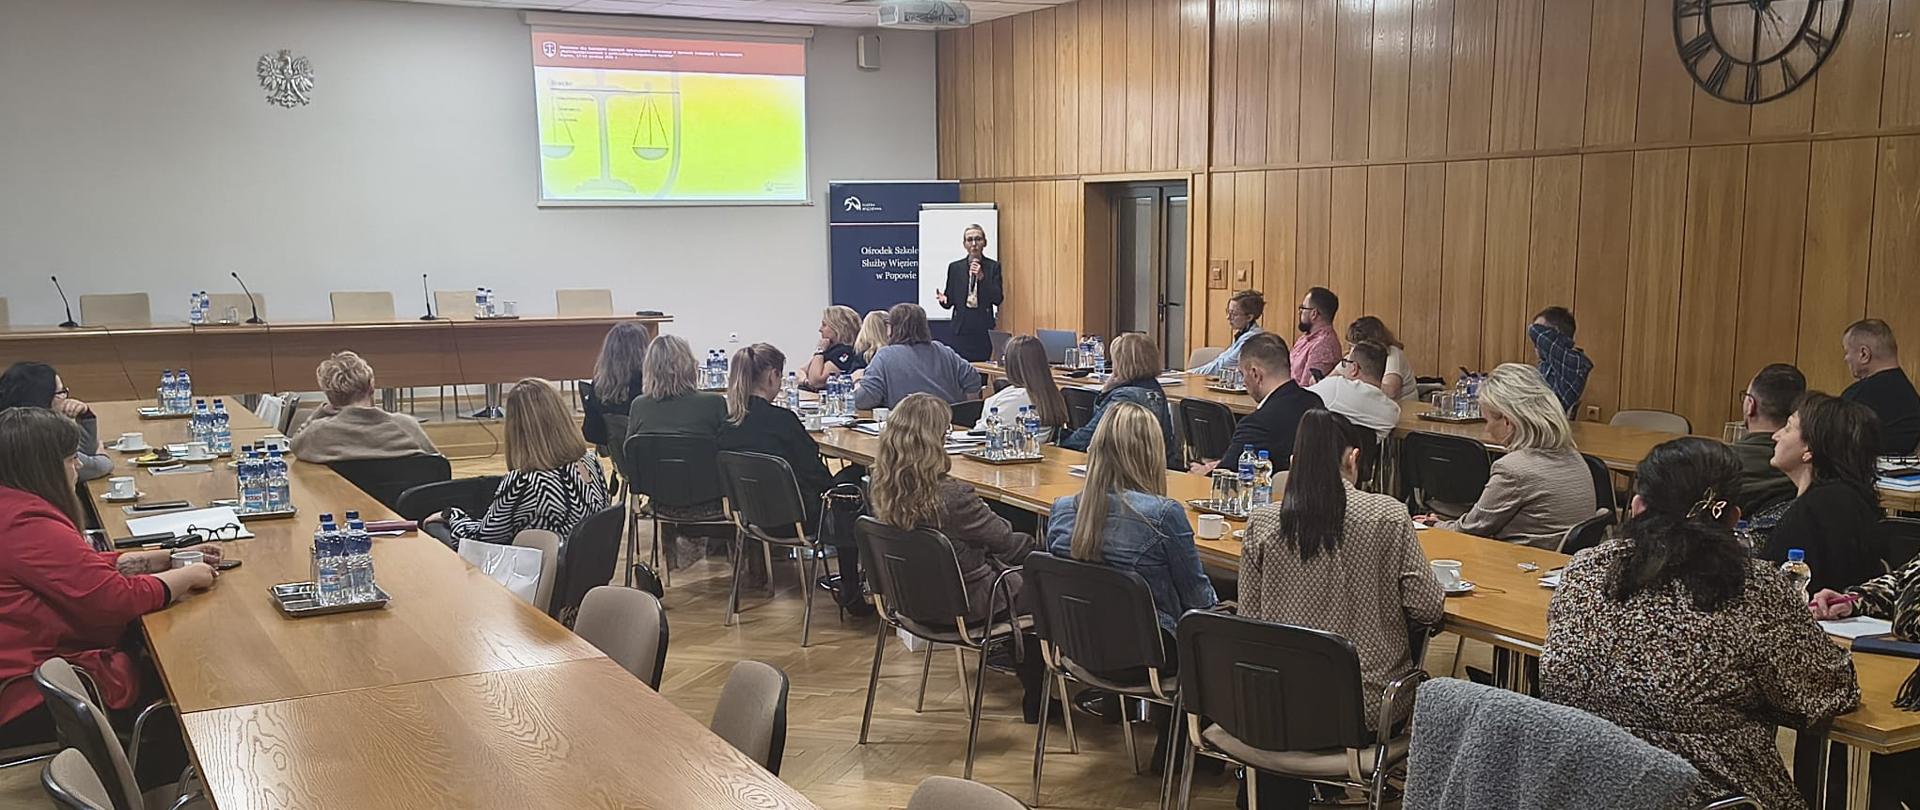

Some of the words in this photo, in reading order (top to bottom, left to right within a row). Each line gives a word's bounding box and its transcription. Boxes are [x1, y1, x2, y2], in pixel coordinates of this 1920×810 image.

[861, 246, 893, 255] Ośrodek
[862, 258, 888, 269] Służby
[885, 271, 917, 281] Popowie
